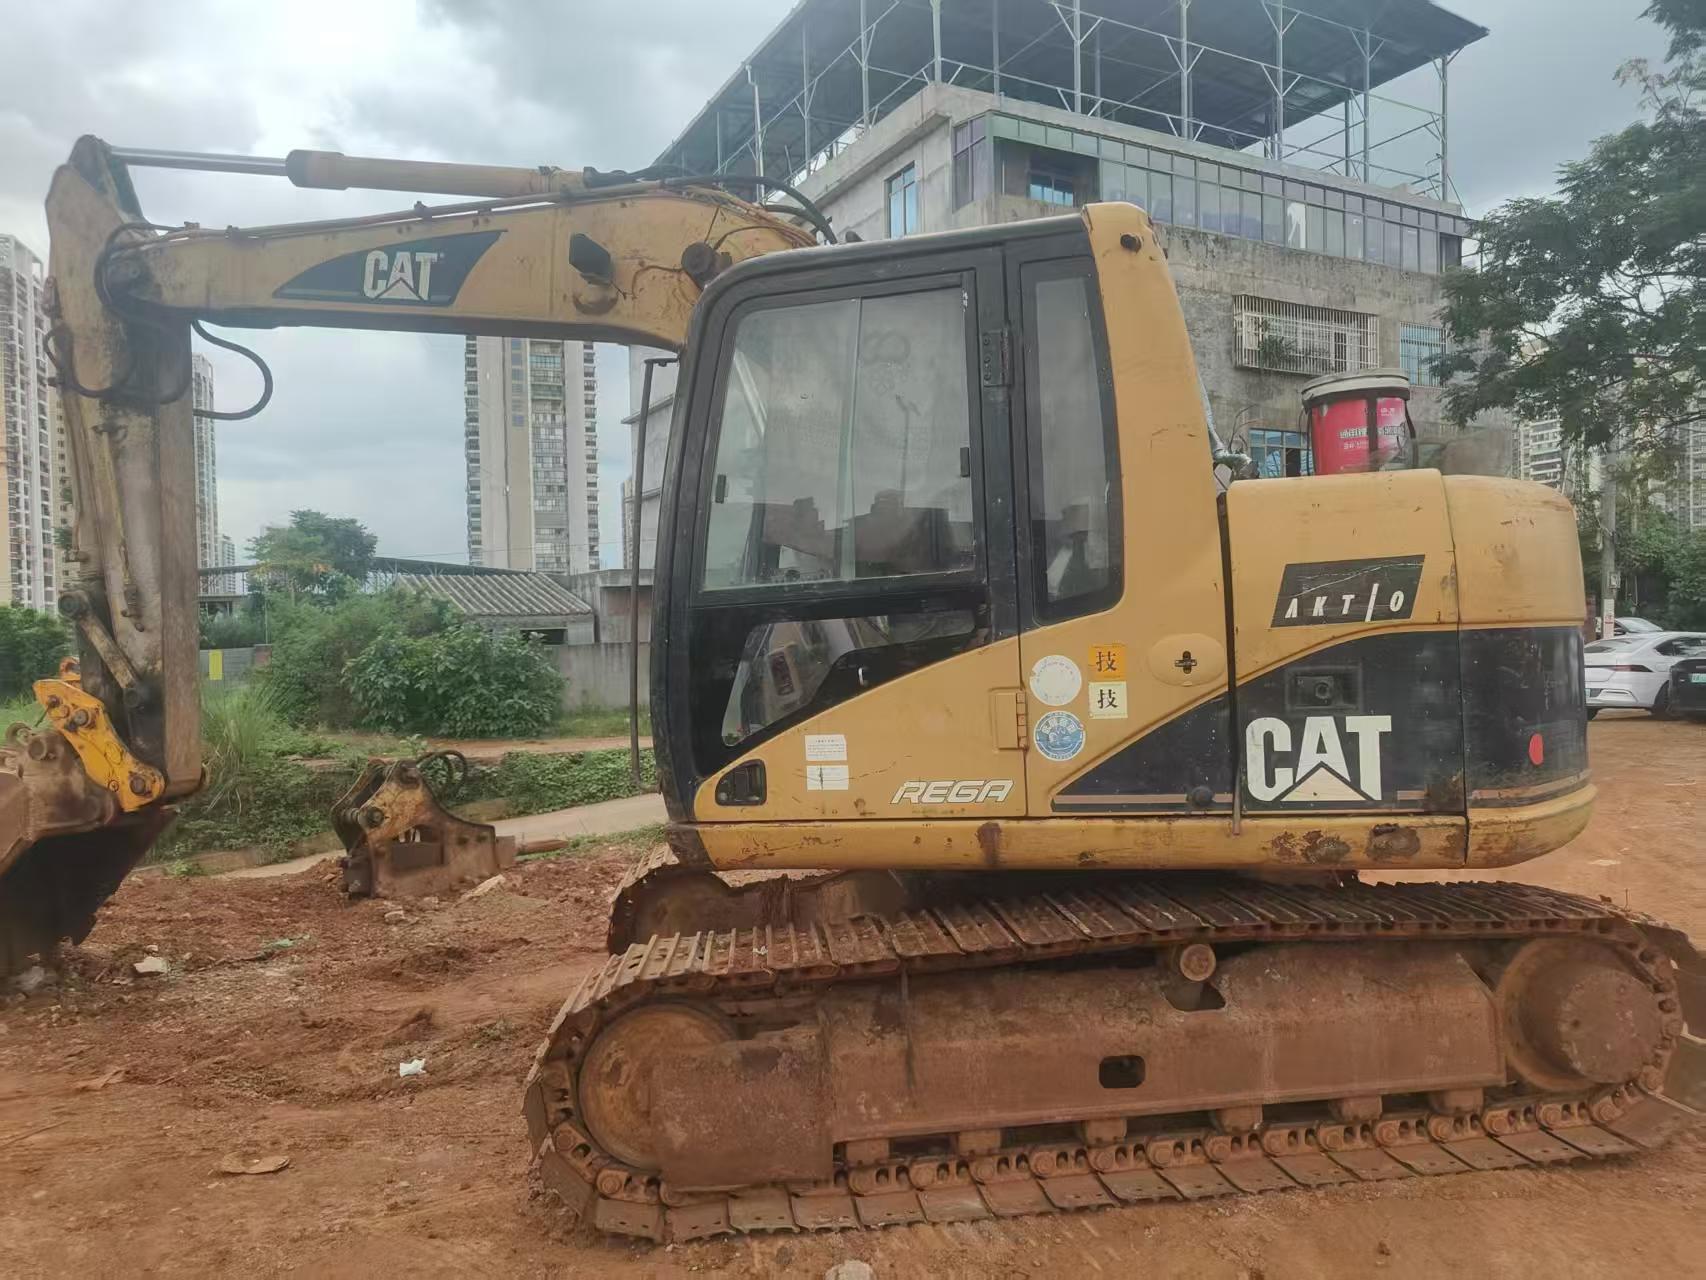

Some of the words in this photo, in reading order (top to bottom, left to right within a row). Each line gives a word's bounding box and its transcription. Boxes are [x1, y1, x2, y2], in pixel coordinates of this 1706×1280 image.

[363, 250, 438, 301] CAT
[1095, 651, 1117, 673] 技
[1097, 688, 1118, 709] 技
[1245, 715, 1392, 802] CAT
[889, 779, 1015, 804] REGA
